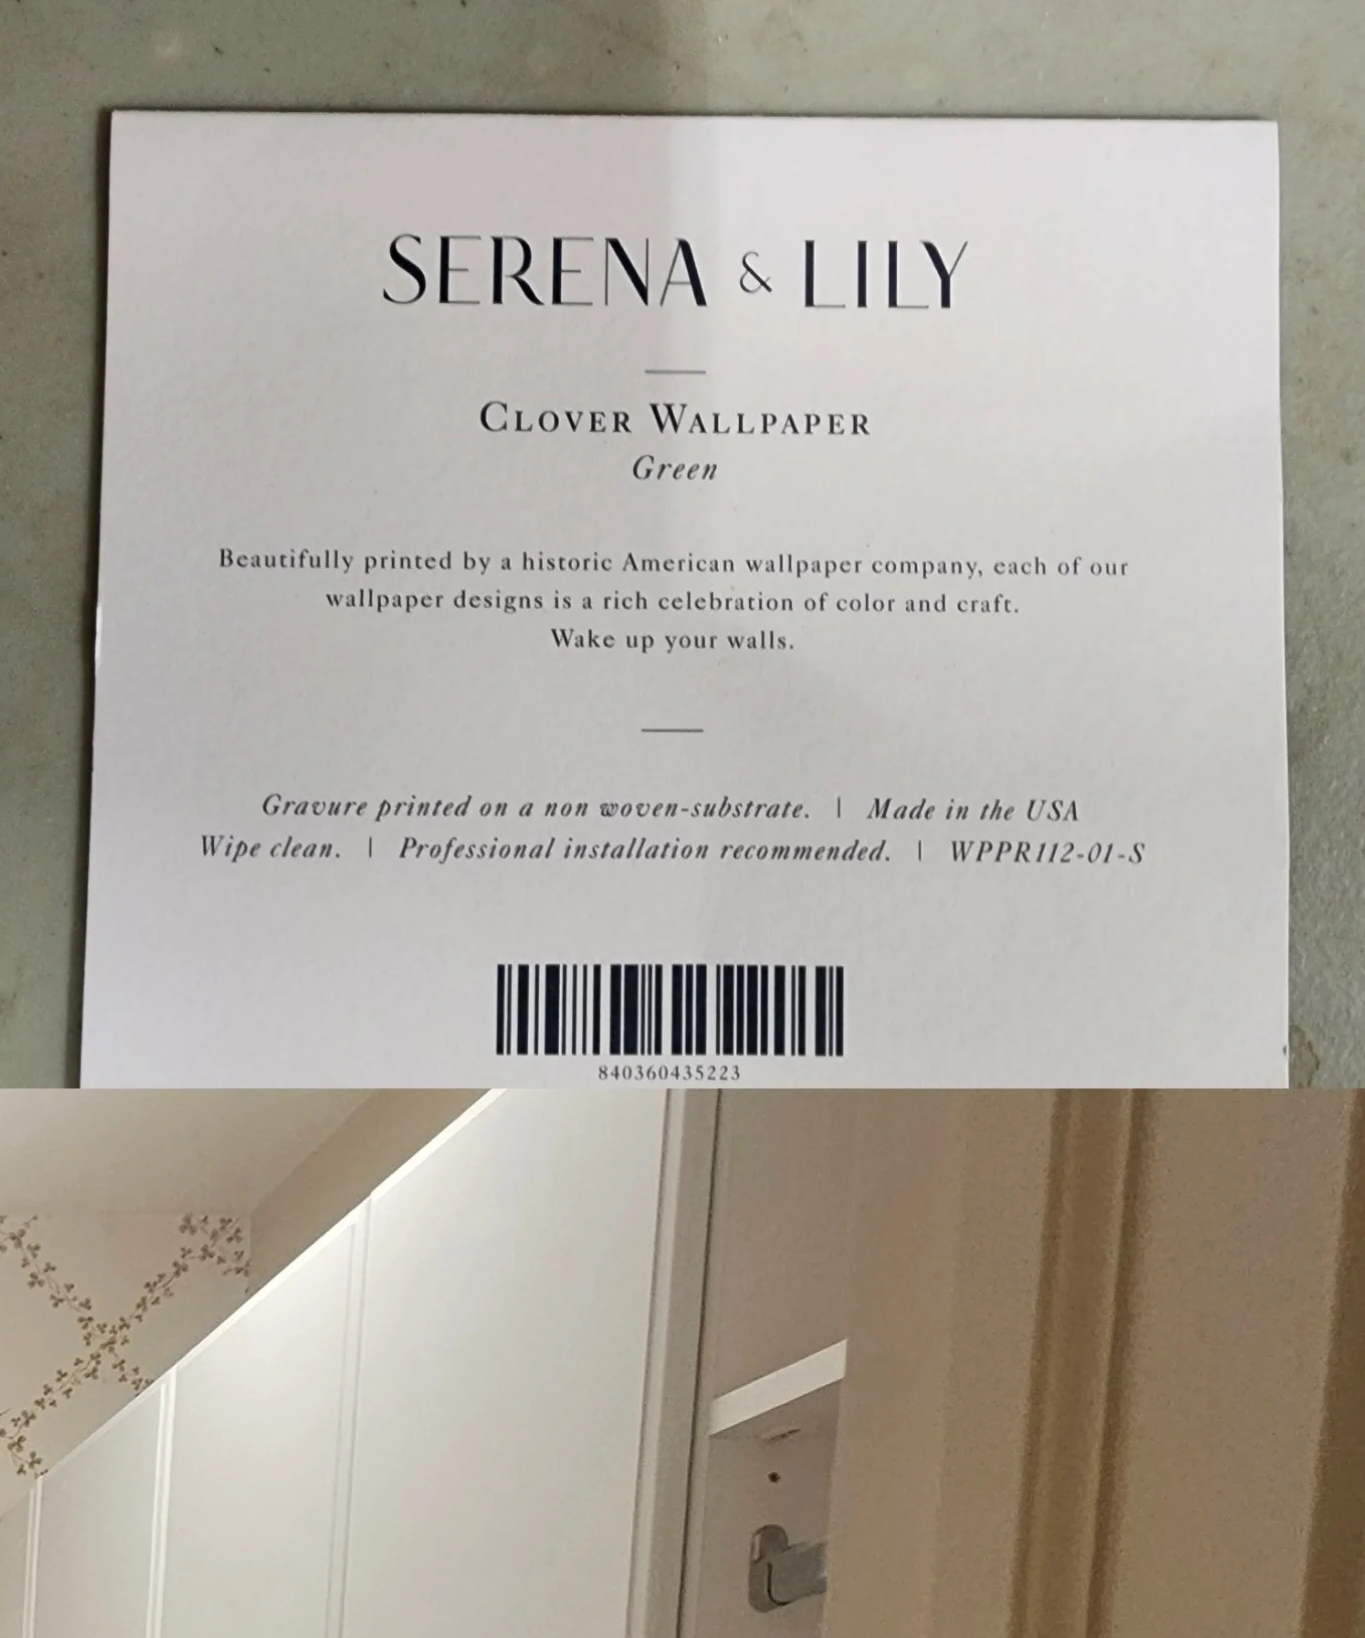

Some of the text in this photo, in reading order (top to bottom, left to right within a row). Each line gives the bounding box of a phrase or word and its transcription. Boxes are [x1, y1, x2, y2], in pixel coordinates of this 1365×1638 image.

[383, 233, 968, 310] SERENA & LILY
[480, 400, 870, 435] CLOVER WALLPAPER
[633, 454, 717, 480] Green
[219, 548, 1128, 580] Beautifully printed by a historic American wallpaper company, each of our
[326, 588, 1019, 614] wallpaper designs is a rich celebration of color and craft.
[551, 628, 794, 654] Wake up your walls.
[262, 793, 1078, 822] Gravure printed on a non woven-substrate. Made in the USA
[201, 834, 1145, 865] Wipe clean. Professional installation recommended. WPPR112-01-S
[598, 1065, 740, 1081] 840360435223
